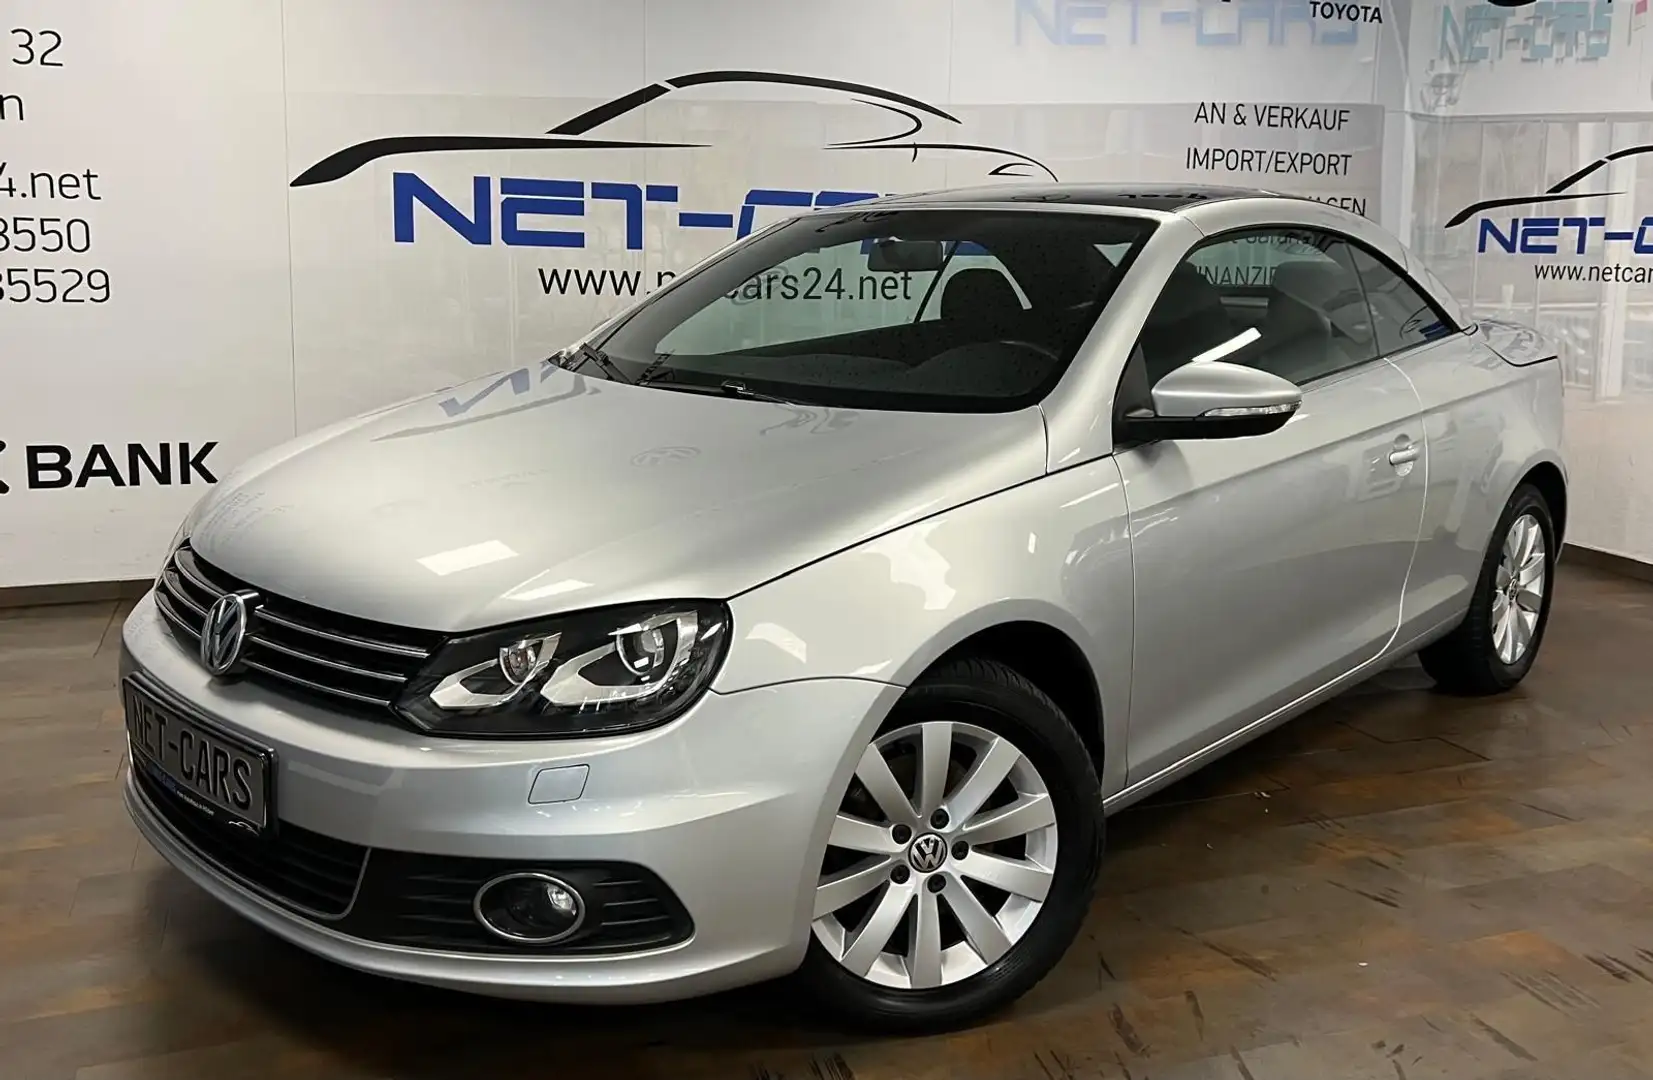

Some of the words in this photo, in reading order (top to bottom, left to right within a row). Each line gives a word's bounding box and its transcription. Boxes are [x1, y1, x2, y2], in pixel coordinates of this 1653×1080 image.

[1310, 1, 1383, 24] TOYOTA
[11, 28, 64, 67] 32
[1194, 102, 1226, 125] AN
[1233, 105, 1247, 126] &
[1254, 105, 1350, 131] VERKAUF
[1186, 147, 1353, 176] IMPORT/EXPORT
[0, 268, 110, 303] 5529
[538, 266, 912, 301] www.nars24.net
[26, 441, 219, 490] BANK
[131, 694, 254, 811] NET-CARS
